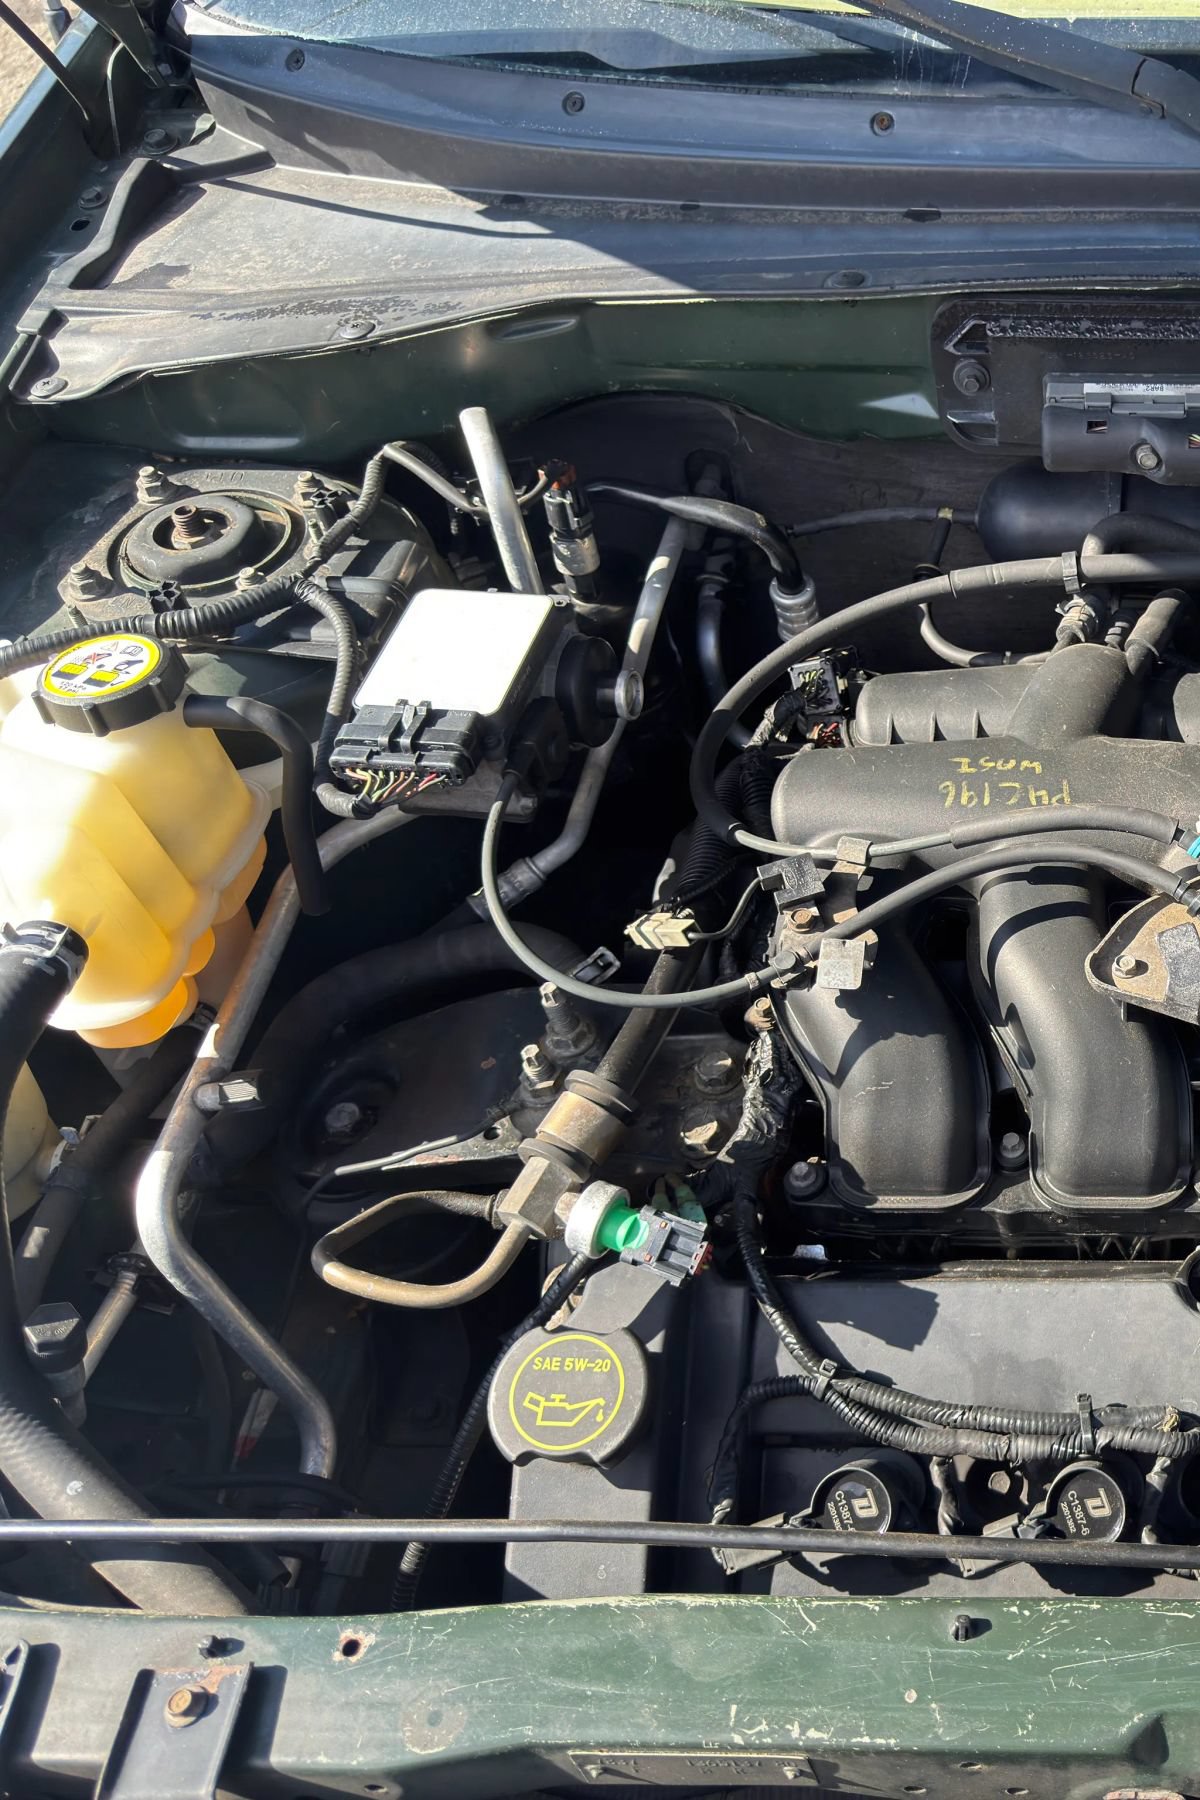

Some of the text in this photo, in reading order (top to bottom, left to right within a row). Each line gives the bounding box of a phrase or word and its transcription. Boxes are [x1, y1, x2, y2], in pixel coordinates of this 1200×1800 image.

[533, 1357, 611, 1372] SAE 5W-20
[1068, 1490, 1090, 1536] C1387-6
